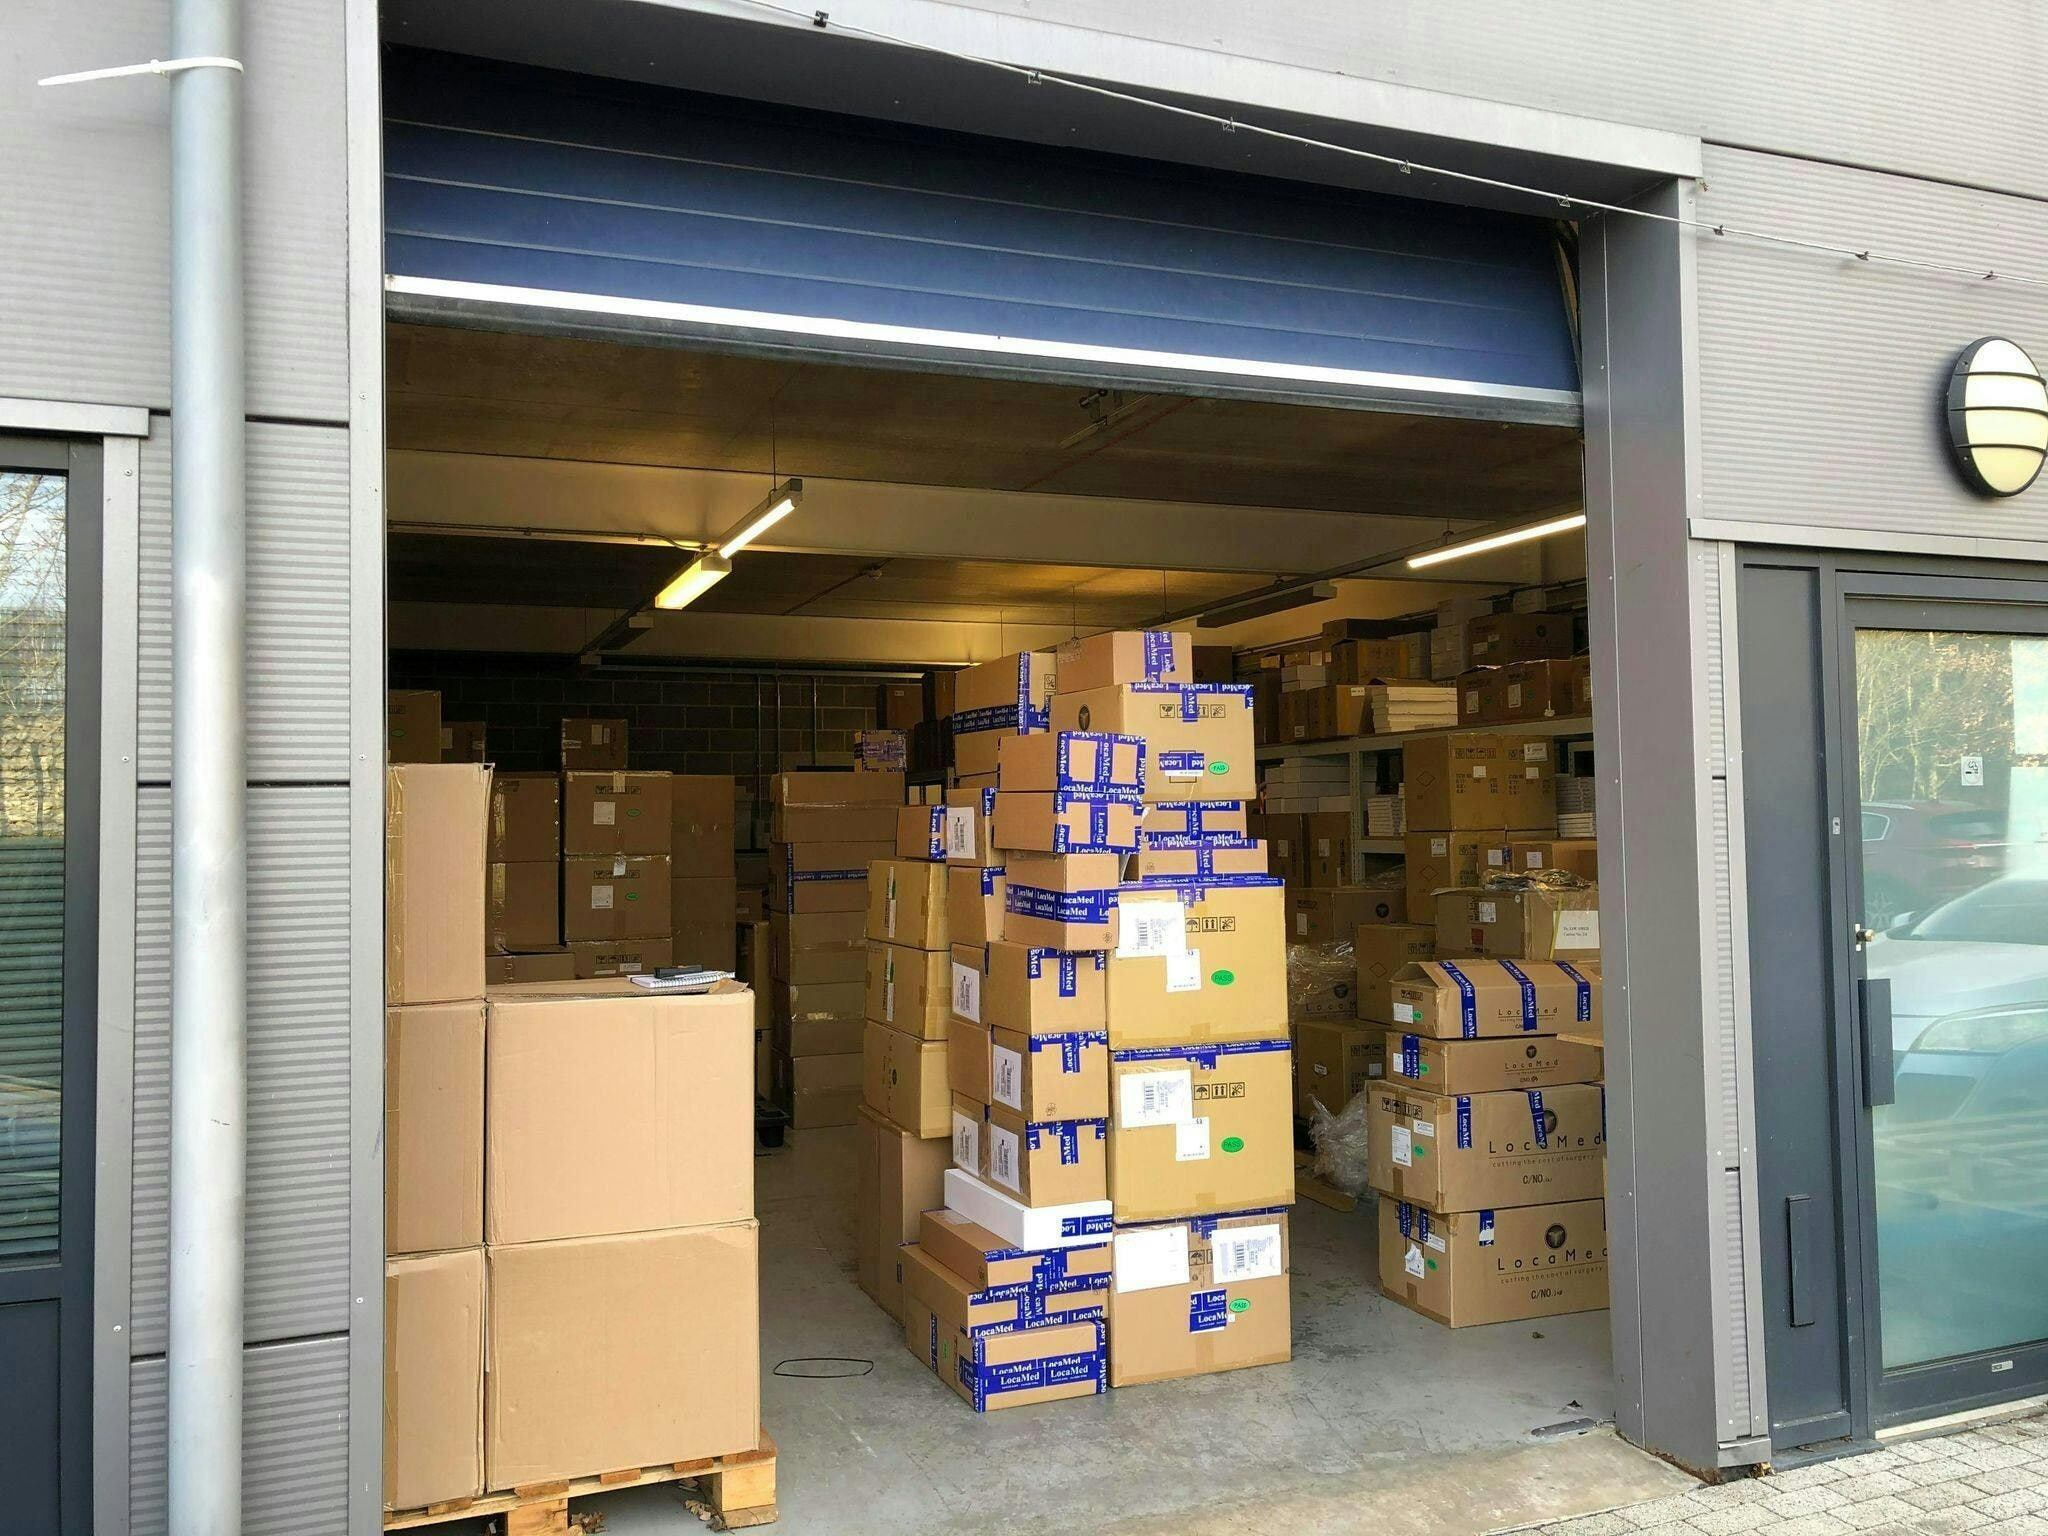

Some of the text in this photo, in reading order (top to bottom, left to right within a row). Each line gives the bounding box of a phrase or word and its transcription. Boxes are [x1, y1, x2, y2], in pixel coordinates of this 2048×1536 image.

[1180, 684, 1213, 692] LocaMed
[1103, 742, 1111, 776] ocaMed
[1103, 786, 1138, 795] LocaMed
[1073, 792, 1110, 801] LocaMed
[1199, 801, 1232, 810] LocaMed
[1060, 895, 1095, 905] LocaMed
[1057, 906, 1088, 917] LocaMed
[1454, 971, 1473, 997] LocaMed
[1525, 984, 1536, 1019] LocaMed
[1504, 1059, 1559, 1070] LocaMed
[1233, 1301, 1248, 1310] PASS
[975, 1324, 1014, 1340] LocaMed
[1025, 1315, 1063, 1329] LocaMed
[1000, 1371, 1040, 1386] LocaMed
[1050, 1364, 1089, 1379] LocaMed
